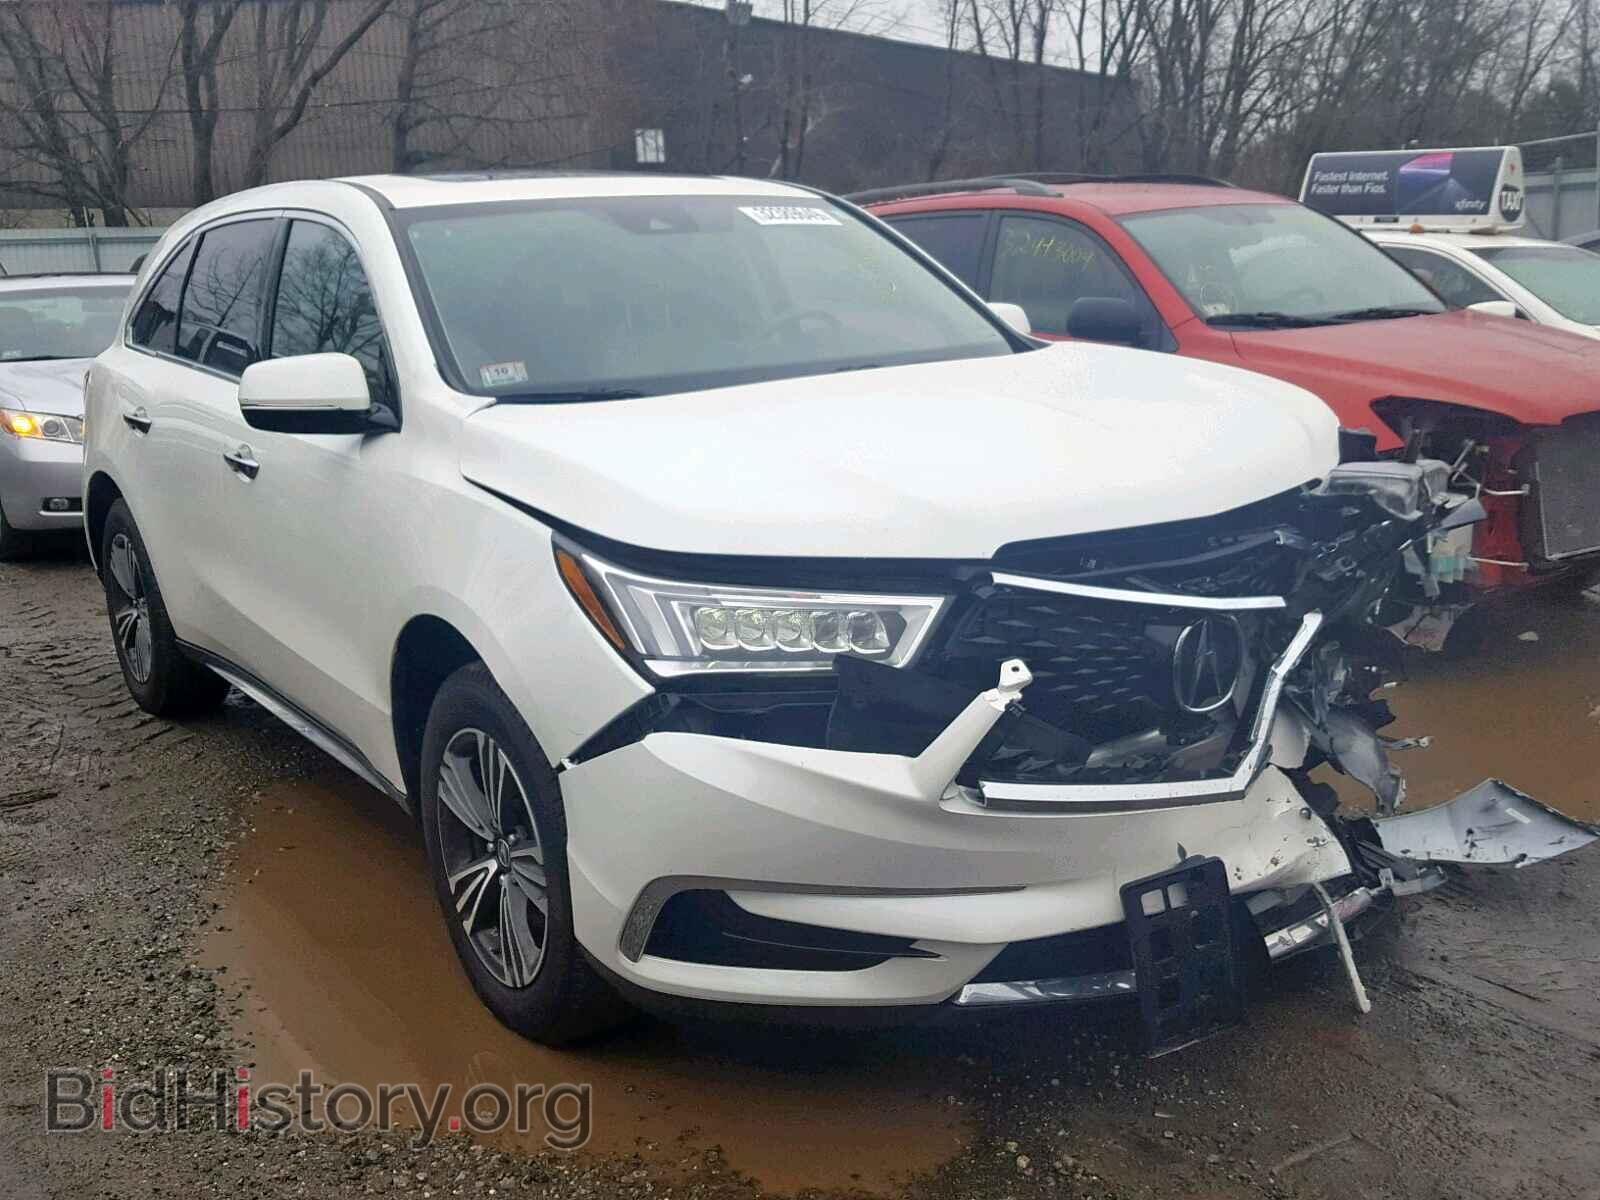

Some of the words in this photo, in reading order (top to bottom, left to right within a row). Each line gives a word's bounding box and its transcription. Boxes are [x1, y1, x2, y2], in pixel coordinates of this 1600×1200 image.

[1313, 171, 1347, 182] Fastest
[1311, 182, 1339, 195] Faster
[1341, 183, 1362, 194] than
